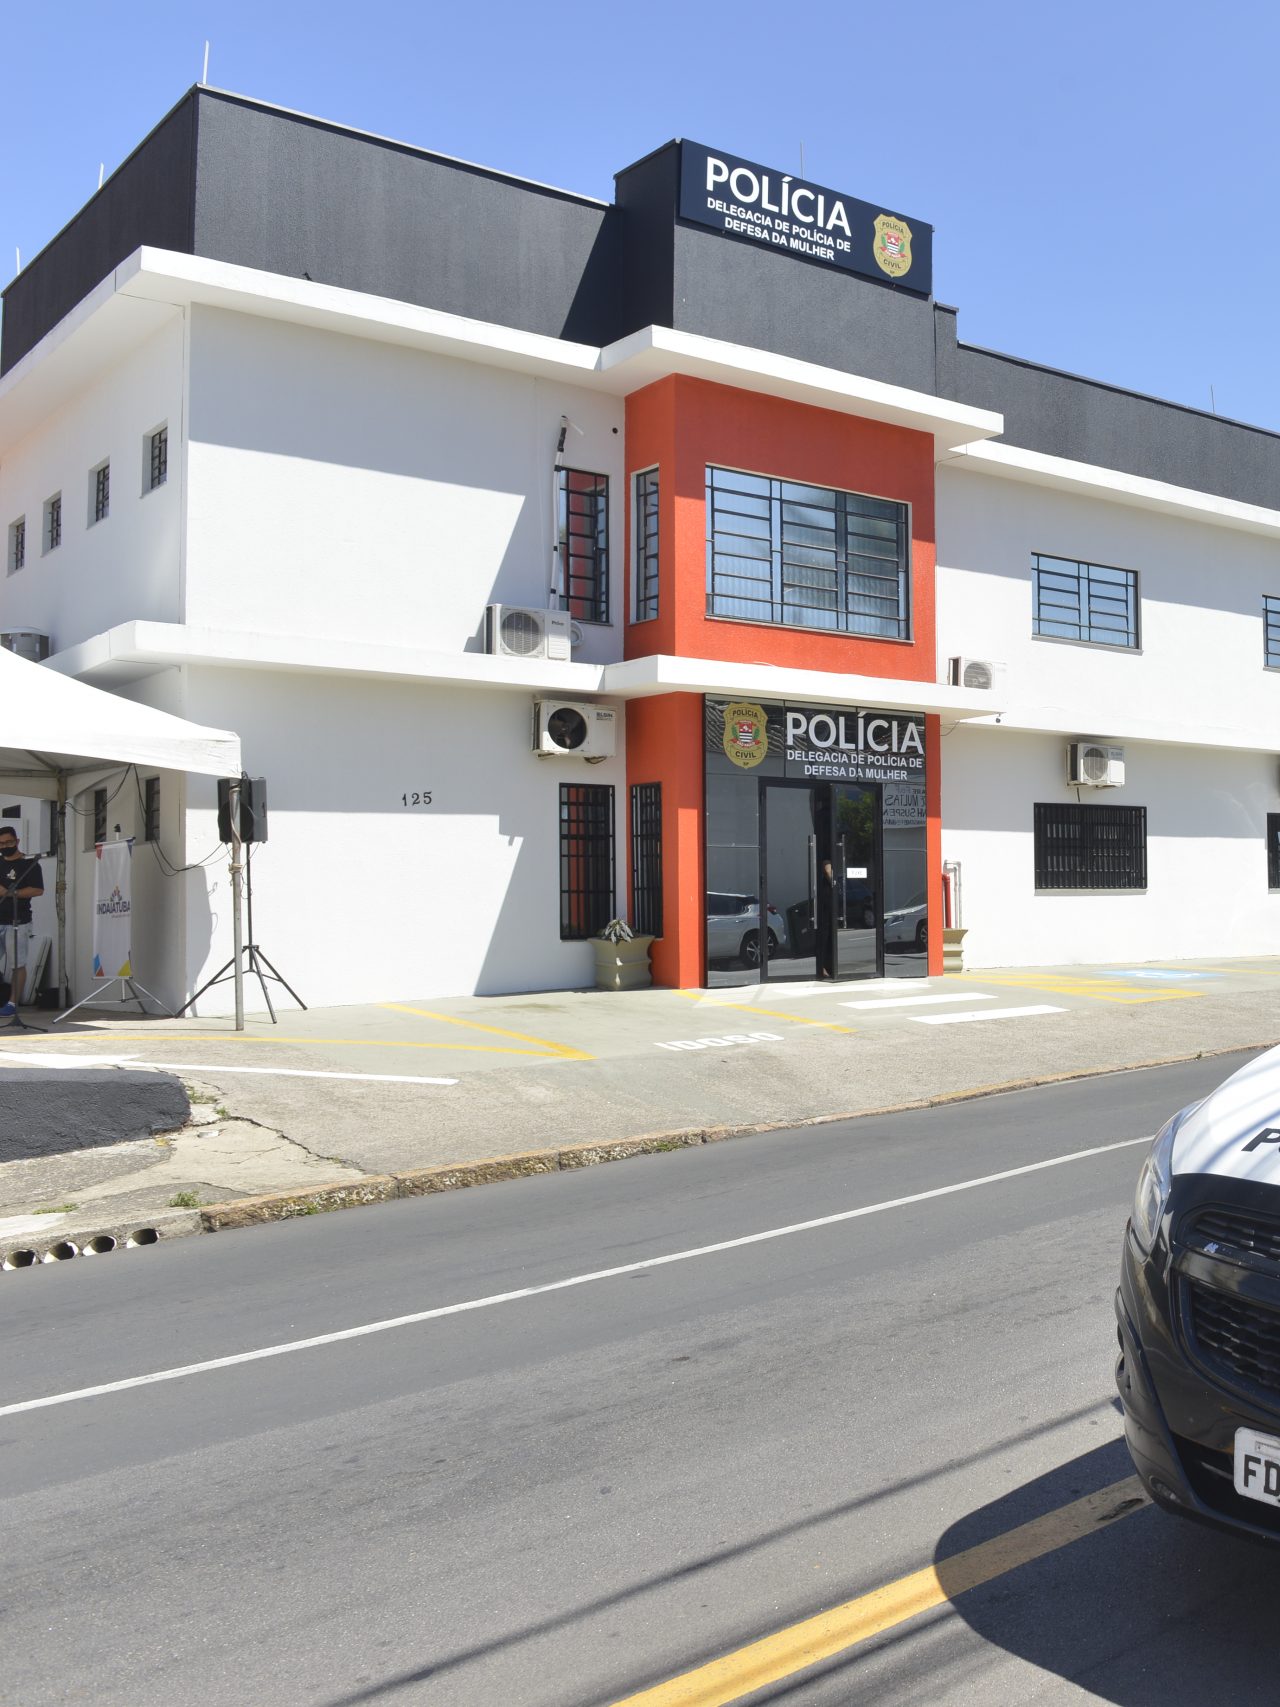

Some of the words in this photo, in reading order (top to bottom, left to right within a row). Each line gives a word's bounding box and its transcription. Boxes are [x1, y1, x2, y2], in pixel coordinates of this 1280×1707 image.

[706, 156, 852, 237] POLÍCIA
[707, 197, 773, 228] DELEGACIA
[775, 219, 790, 233] DE
[792, 224, 834, 247] POLÍCIA
[836, 239, 851, 252] DE
[724, 217, 770, 241] DEFESA
[772, 232, 788, 246] DA
[789, 239, 835, 261] MULHER
[786, 711, 925, 755] POLÍCIA
[787, 750, 849, 763] DELEGACIA
[851, 753, 865, 764] DE
[867, 754, 908, 768] POLÍCIA
[909, 758, 923, 768] DE
[804, 764, 847, 777] DEFESA
[848, 767, 864, 778] DA
[865, 768, 908, 780] MULHER
[402, 791, 432, 806] 125
